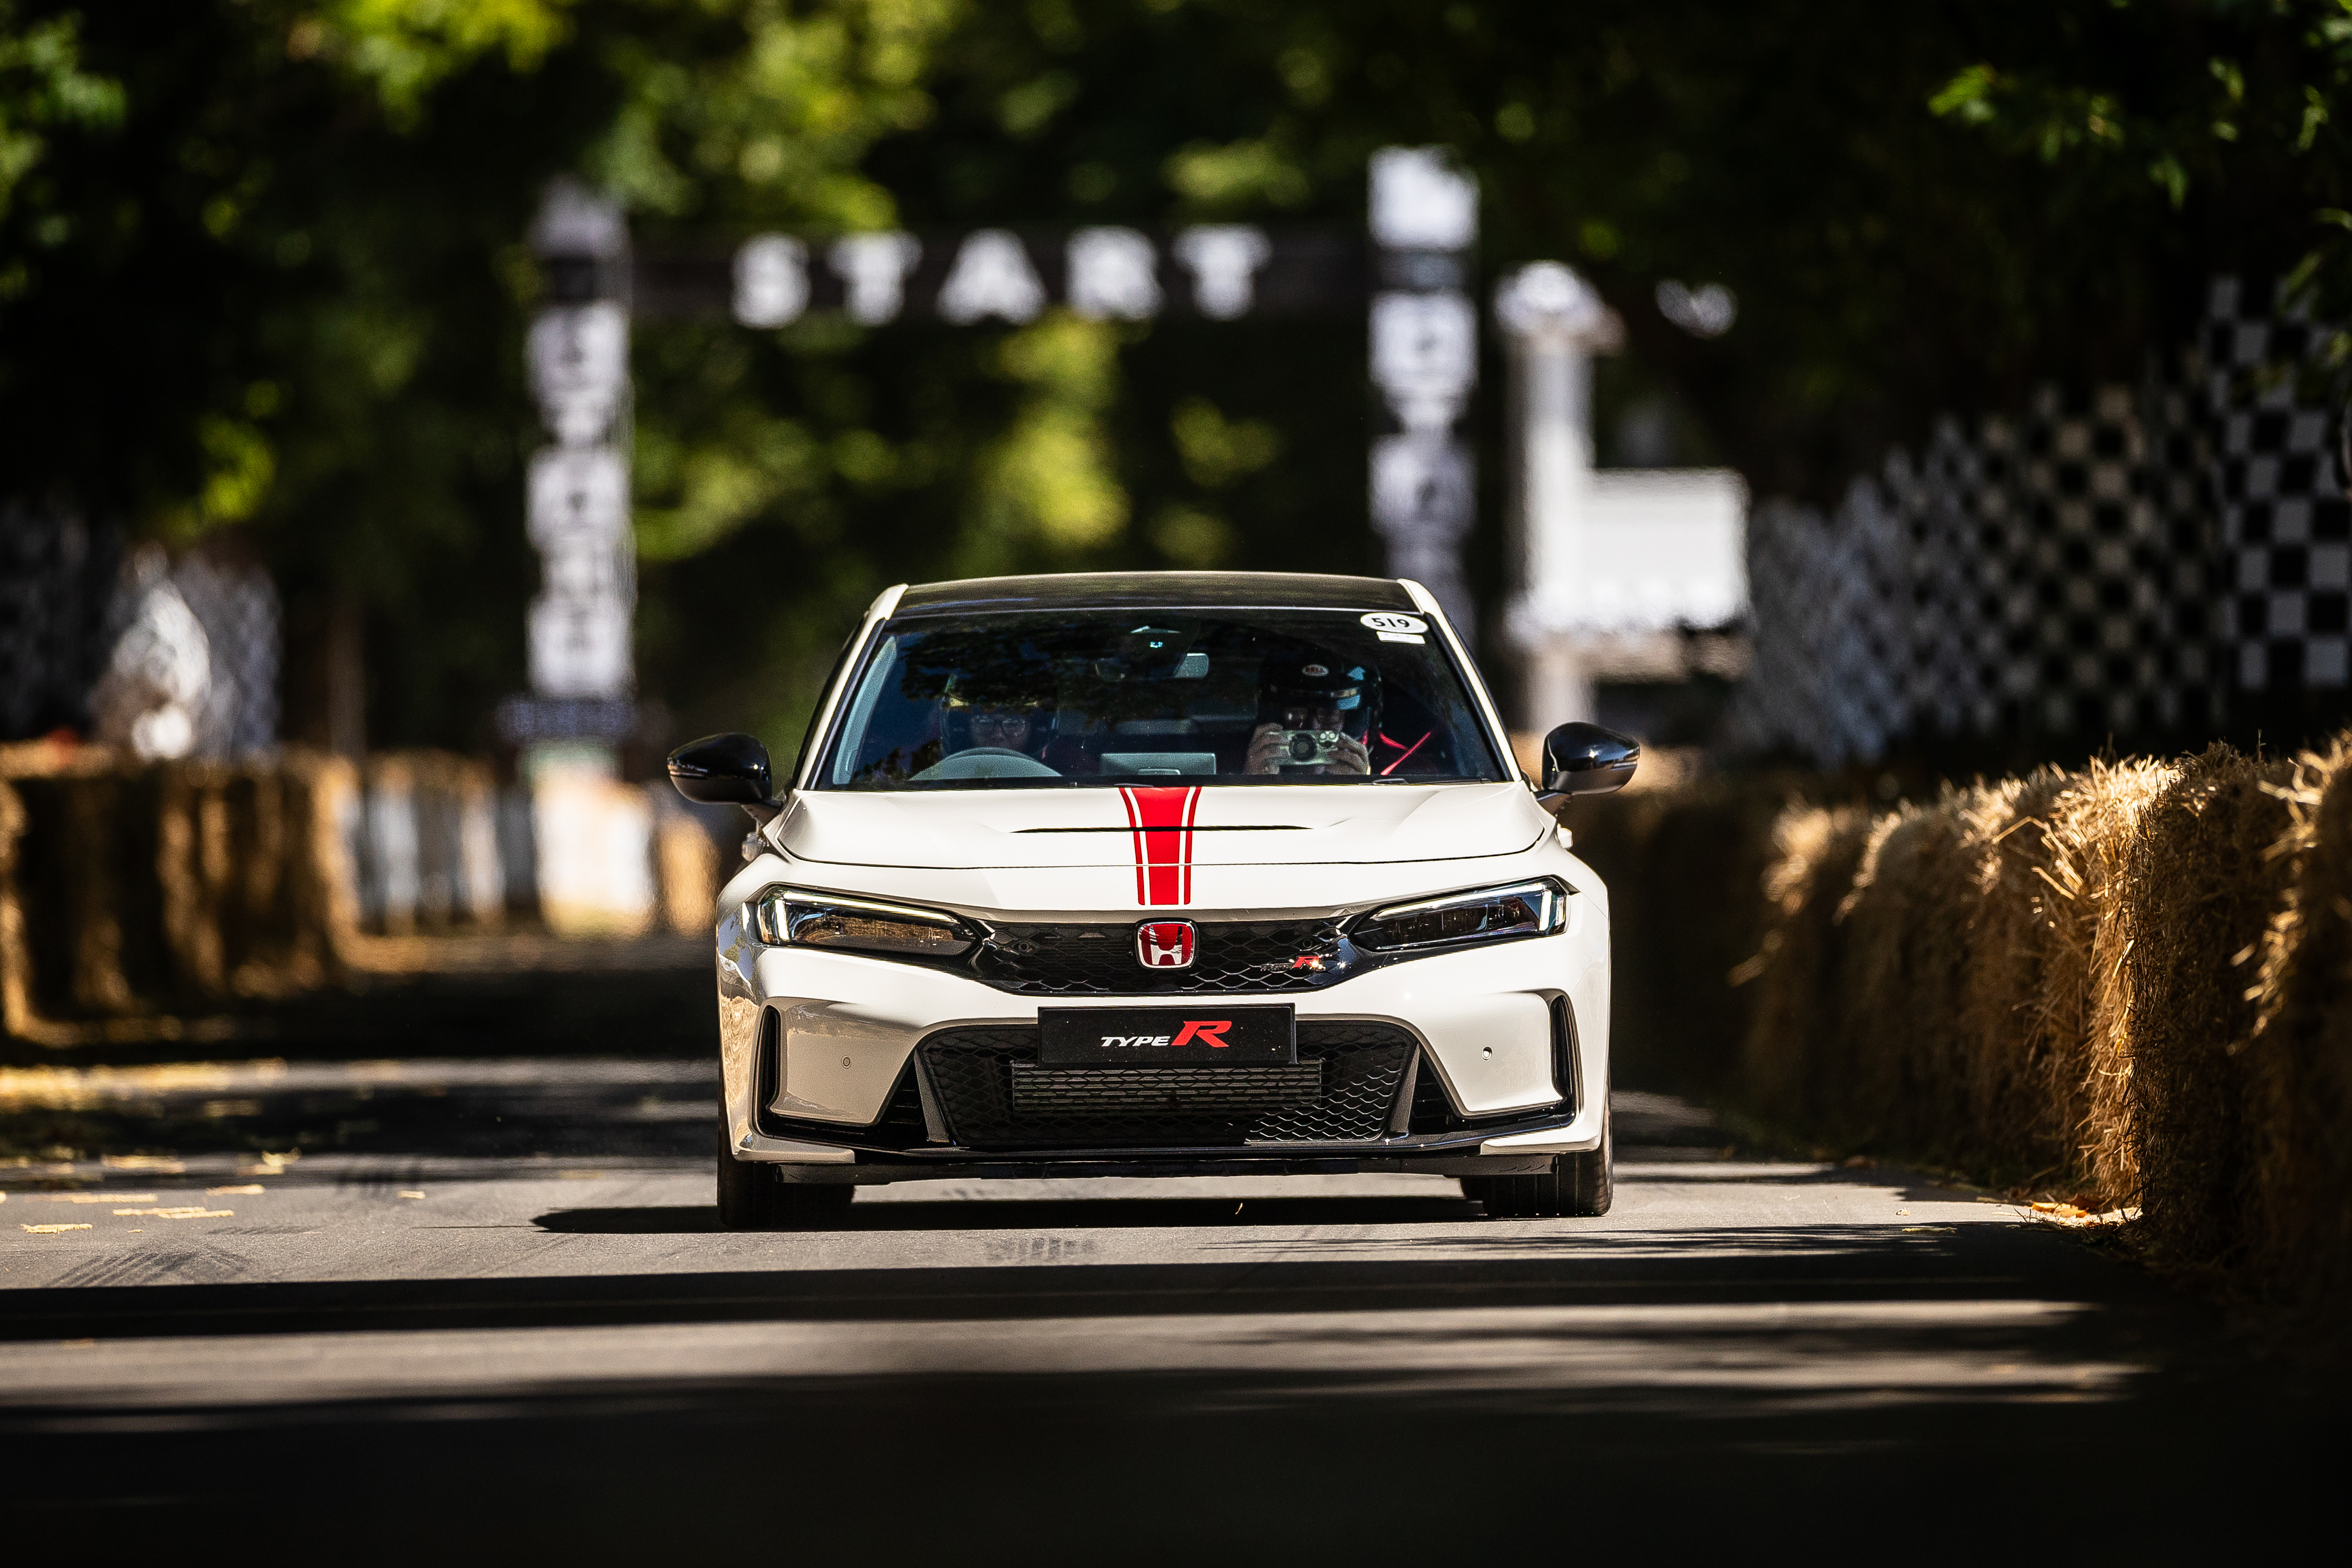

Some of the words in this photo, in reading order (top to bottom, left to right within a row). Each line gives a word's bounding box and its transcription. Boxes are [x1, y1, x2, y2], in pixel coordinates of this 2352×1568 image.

[730, 224, 1272, 328] START
[1371, 617, 1410, 628] 519
[1291, 955, 1325, 971] R
[1101, 1036, 1170, 1047] TYPE
[1171, 1021, 1232, 1048] R
